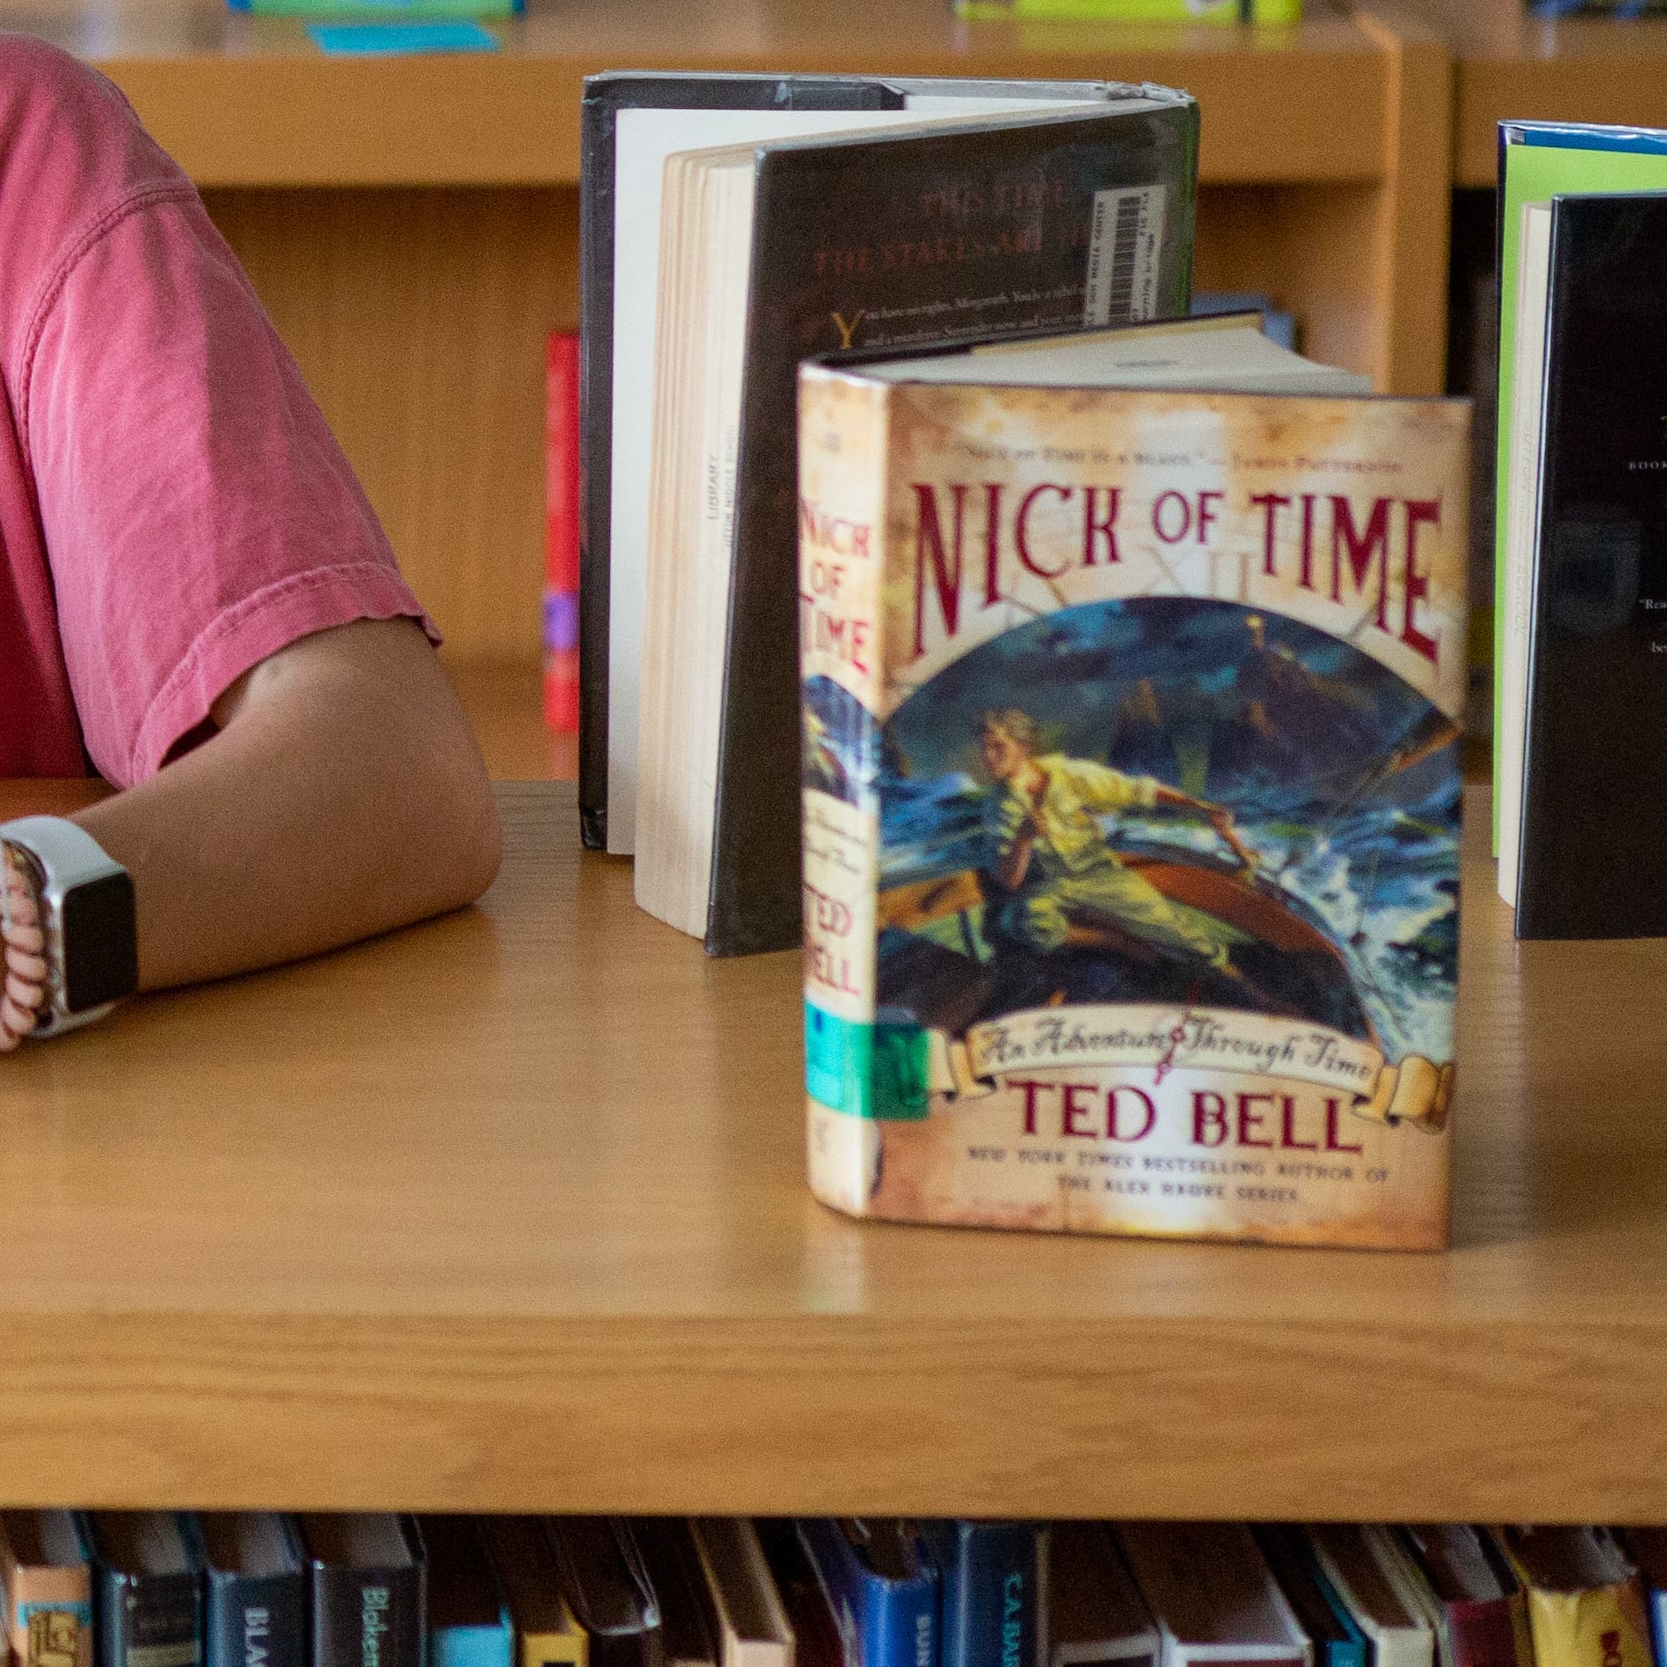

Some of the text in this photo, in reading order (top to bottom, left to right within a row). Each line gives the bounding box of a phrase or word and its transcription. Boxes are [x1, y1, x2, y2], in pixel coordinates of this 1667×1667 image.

[908, 482, 1445, 666] NICK OF TIME
[1005, 1077, 1364, 1155] TED BELL
[1075, 1150, 1135, 1170] TIMES
[1141, 1155, 1266, 1178] BESTSELLING
[1274, 1162, 1354, 1182] AUTHOR
